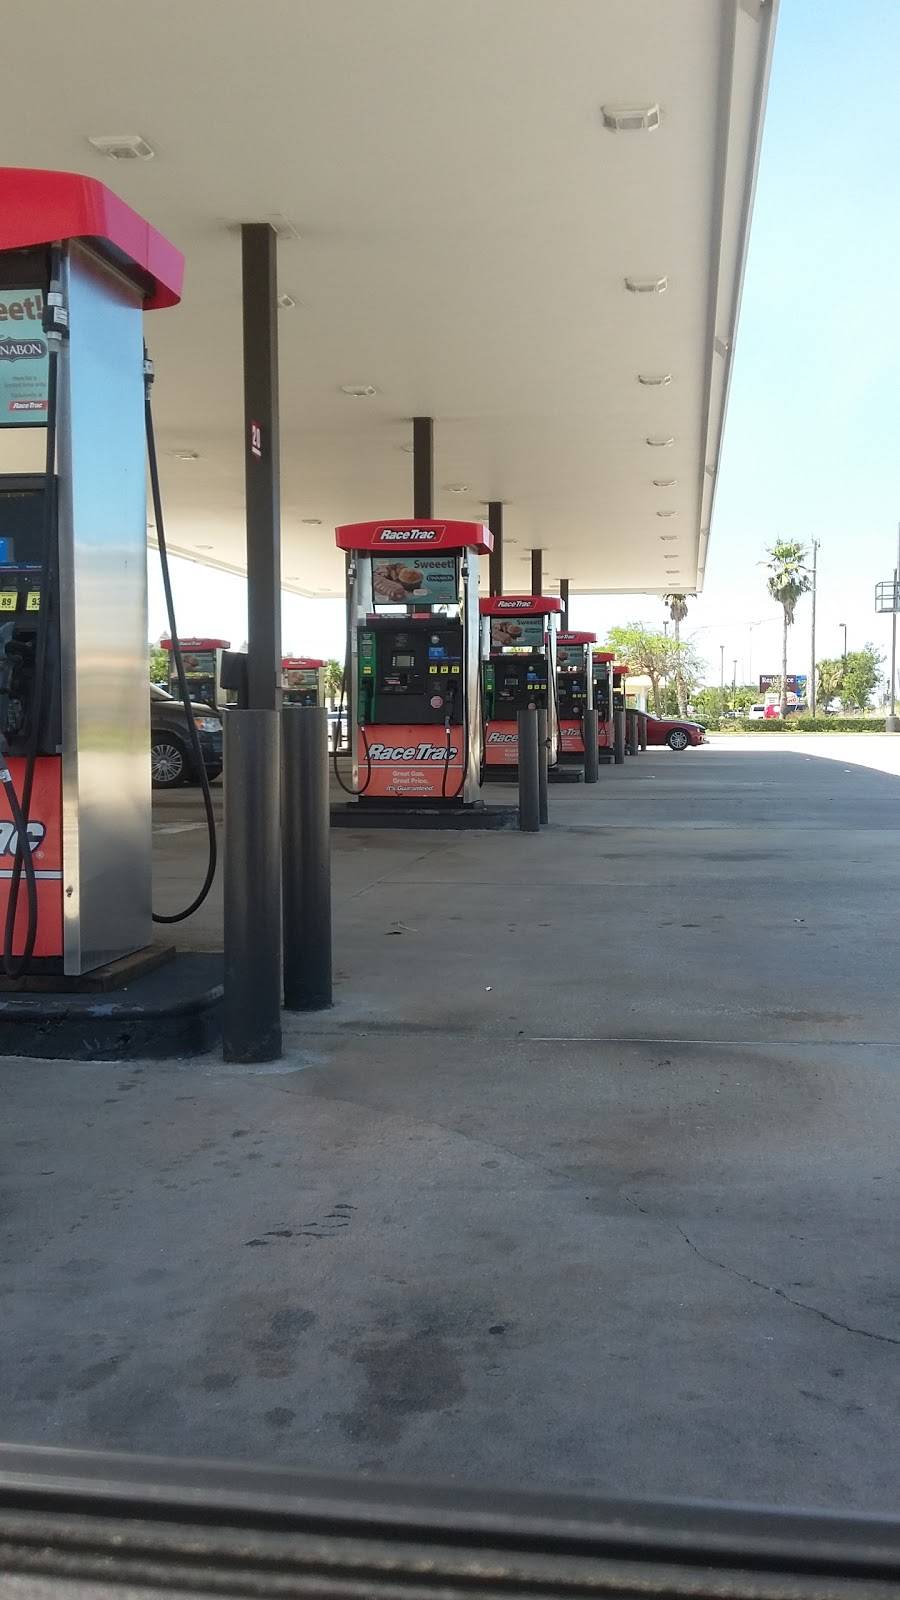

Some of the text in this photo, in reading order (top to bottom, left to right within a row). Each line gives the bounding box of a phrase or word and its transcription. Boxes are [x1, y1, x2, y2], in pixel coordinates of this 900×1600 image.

[380, 529, 437, 541] RaceTrac
[498, 600, 532, 608] RaceTrac
[364, 743, 458, 760] RaceTrac
